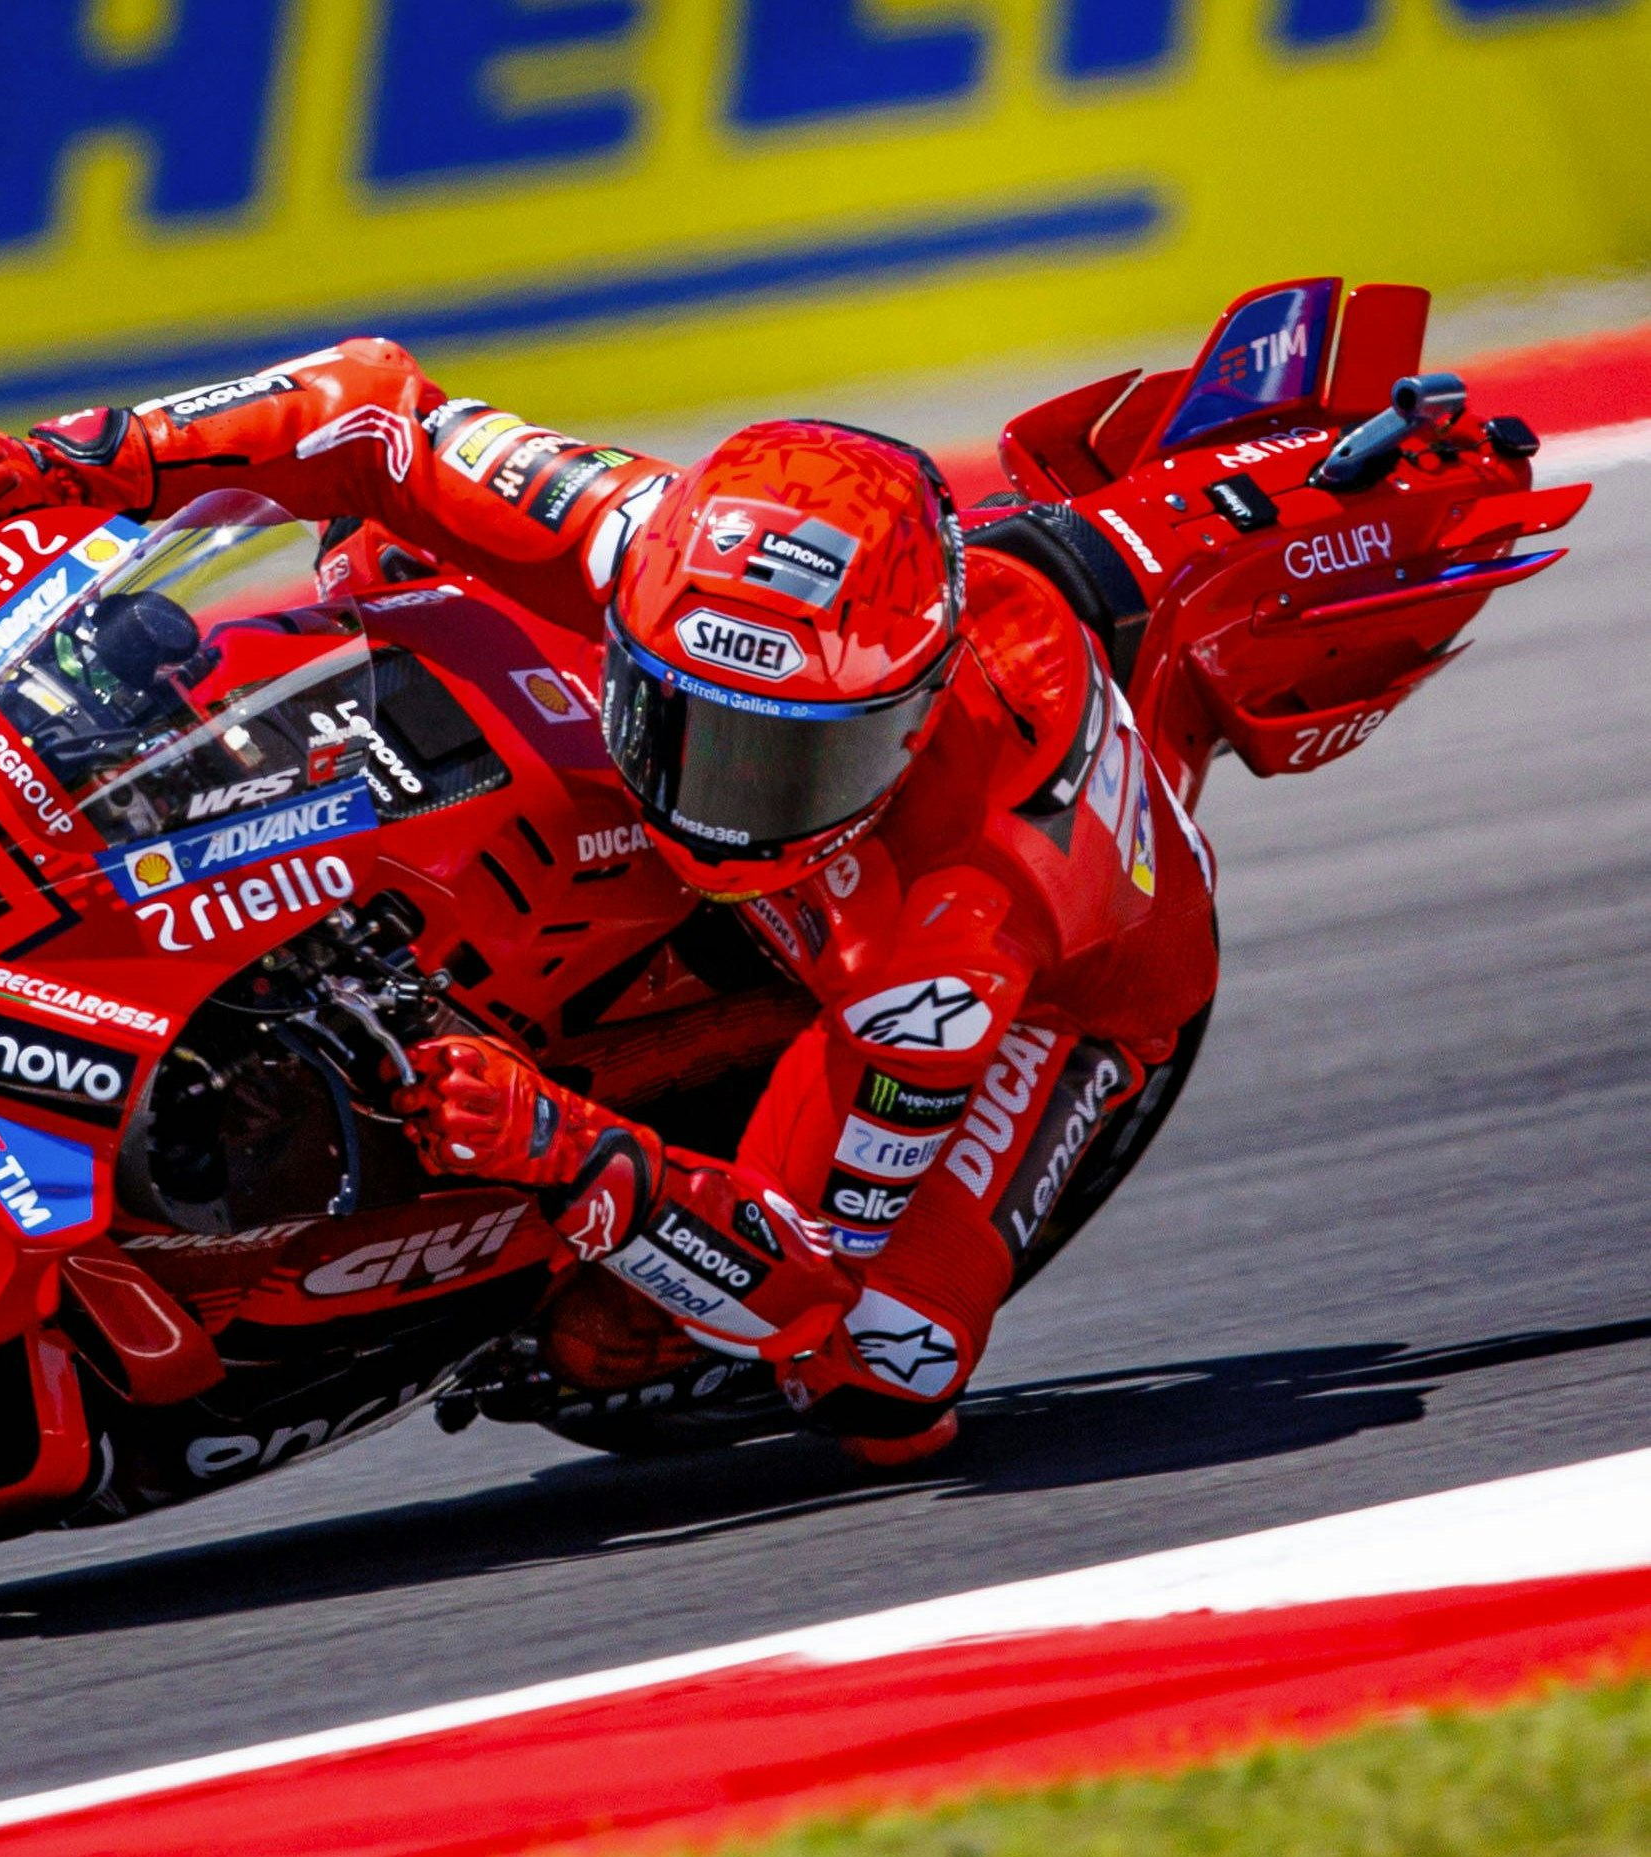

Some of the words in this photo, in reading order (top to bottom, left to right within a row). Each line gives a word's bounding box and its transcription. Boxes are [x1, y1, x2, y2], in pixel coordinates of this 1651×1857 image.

[1251, 325, 1308, 372] TIM
[174, 375, 294, 415] Lenovo
[763, 534, 836, 573] Lenovo
[1098, 508, 1163, 574] DUCATI
[1284, 522, 1392, 580] GELLIFY
[693, 620, 788, 671] SHOEI
[678, 674, 728, 704] Estrella
[730, 693, 780, 716] Galicia
[187, 768, 301, 820] WRS
[199, 797, 348, 869] ADVANCE
[577, 823, 655, 862] DUCA
[945, 1022, 1057, 1199] DUCA
[1011, 1059, 1119, 1248] Lenovo
[302, 1202, 530, 1296] GIVI
[656, 1212, 753, 1288] Lenovo
[630, 1253, 726, 1318] Unipol
